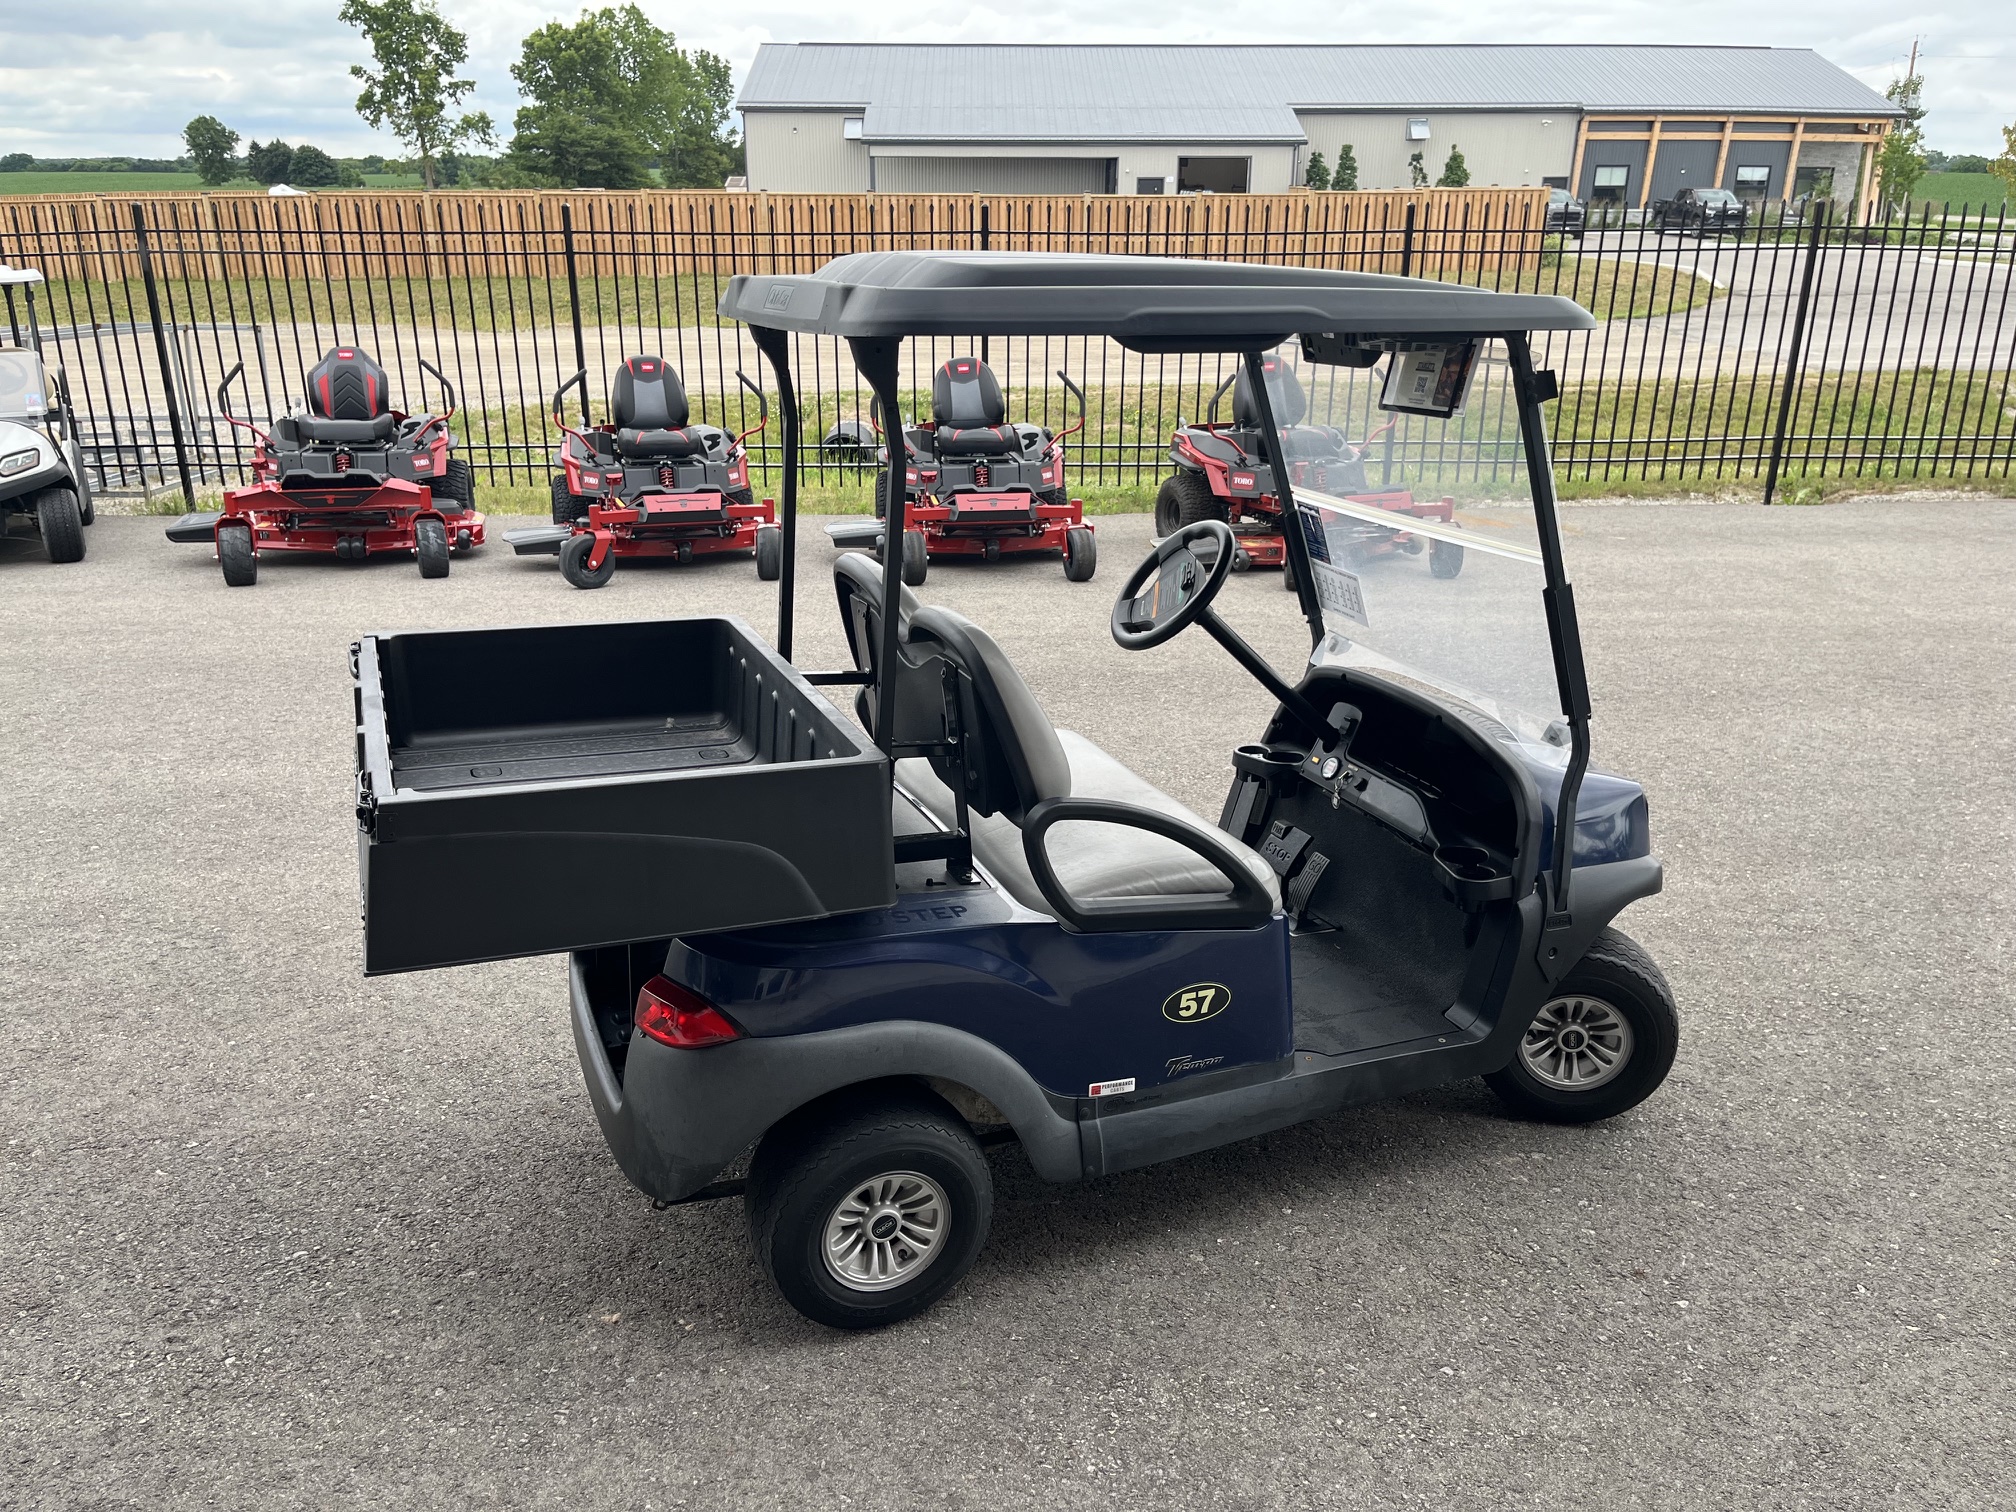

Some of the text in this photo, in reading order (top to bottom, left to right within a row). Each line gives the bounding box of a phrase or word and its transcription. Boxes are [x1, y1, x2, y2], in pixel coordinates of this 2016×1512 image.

[413, 459, 430, 468] TORO
[584, 476, 599, 485] TORO
[1233, 477, 1253, 486] TORO
[1265, 841, 1291, 861] STOP
[1308, 860, 1322, 874] GO
[893, 905, 968, 923] STEP
[1179, 988, 1215, 1017] 57
[1165, 1054, 1224, 1077] Tempo
[1102, 1080, 1133, 1089] PERFORMANCE
